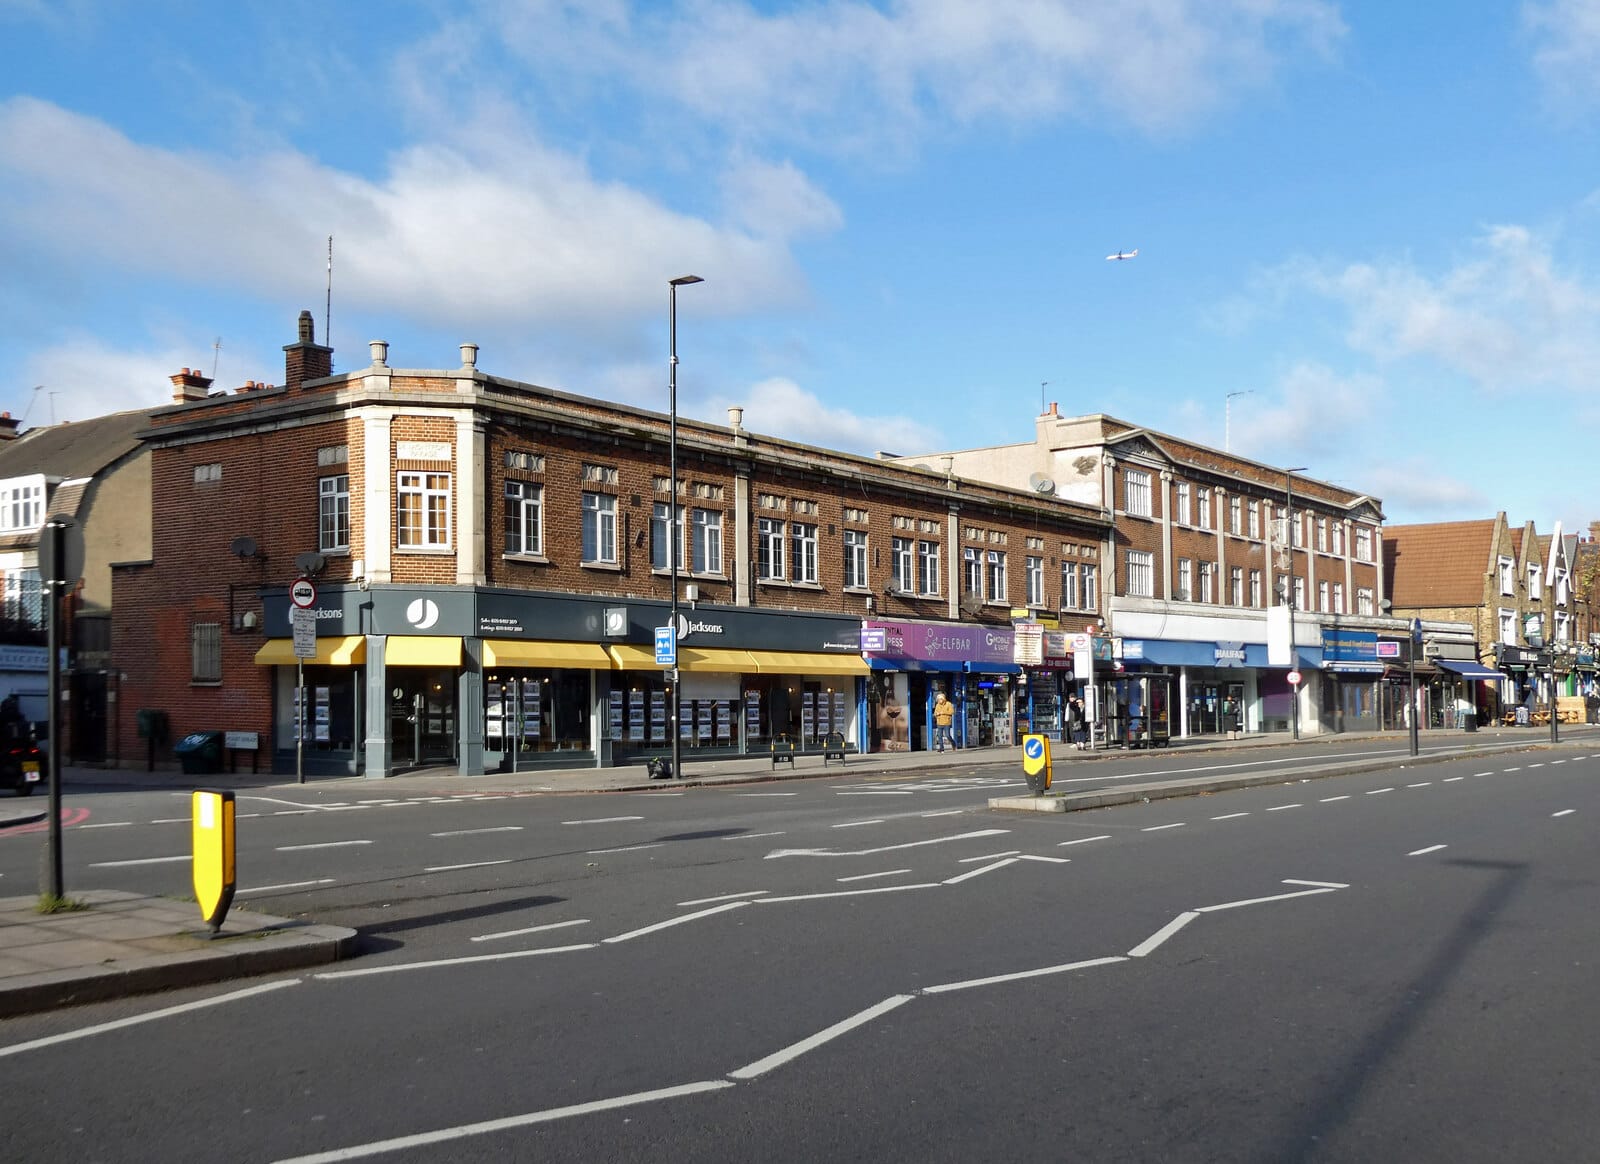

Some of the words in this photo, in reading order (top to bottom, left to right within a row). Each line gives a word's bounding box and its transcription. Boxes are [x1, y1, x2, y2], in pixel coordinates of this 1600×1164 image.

[688, 620, 723, 634] Jacksons
[942, 637, 971, 651] ELFBAR
[1214, 649, 1245, 660] HALIFAX
